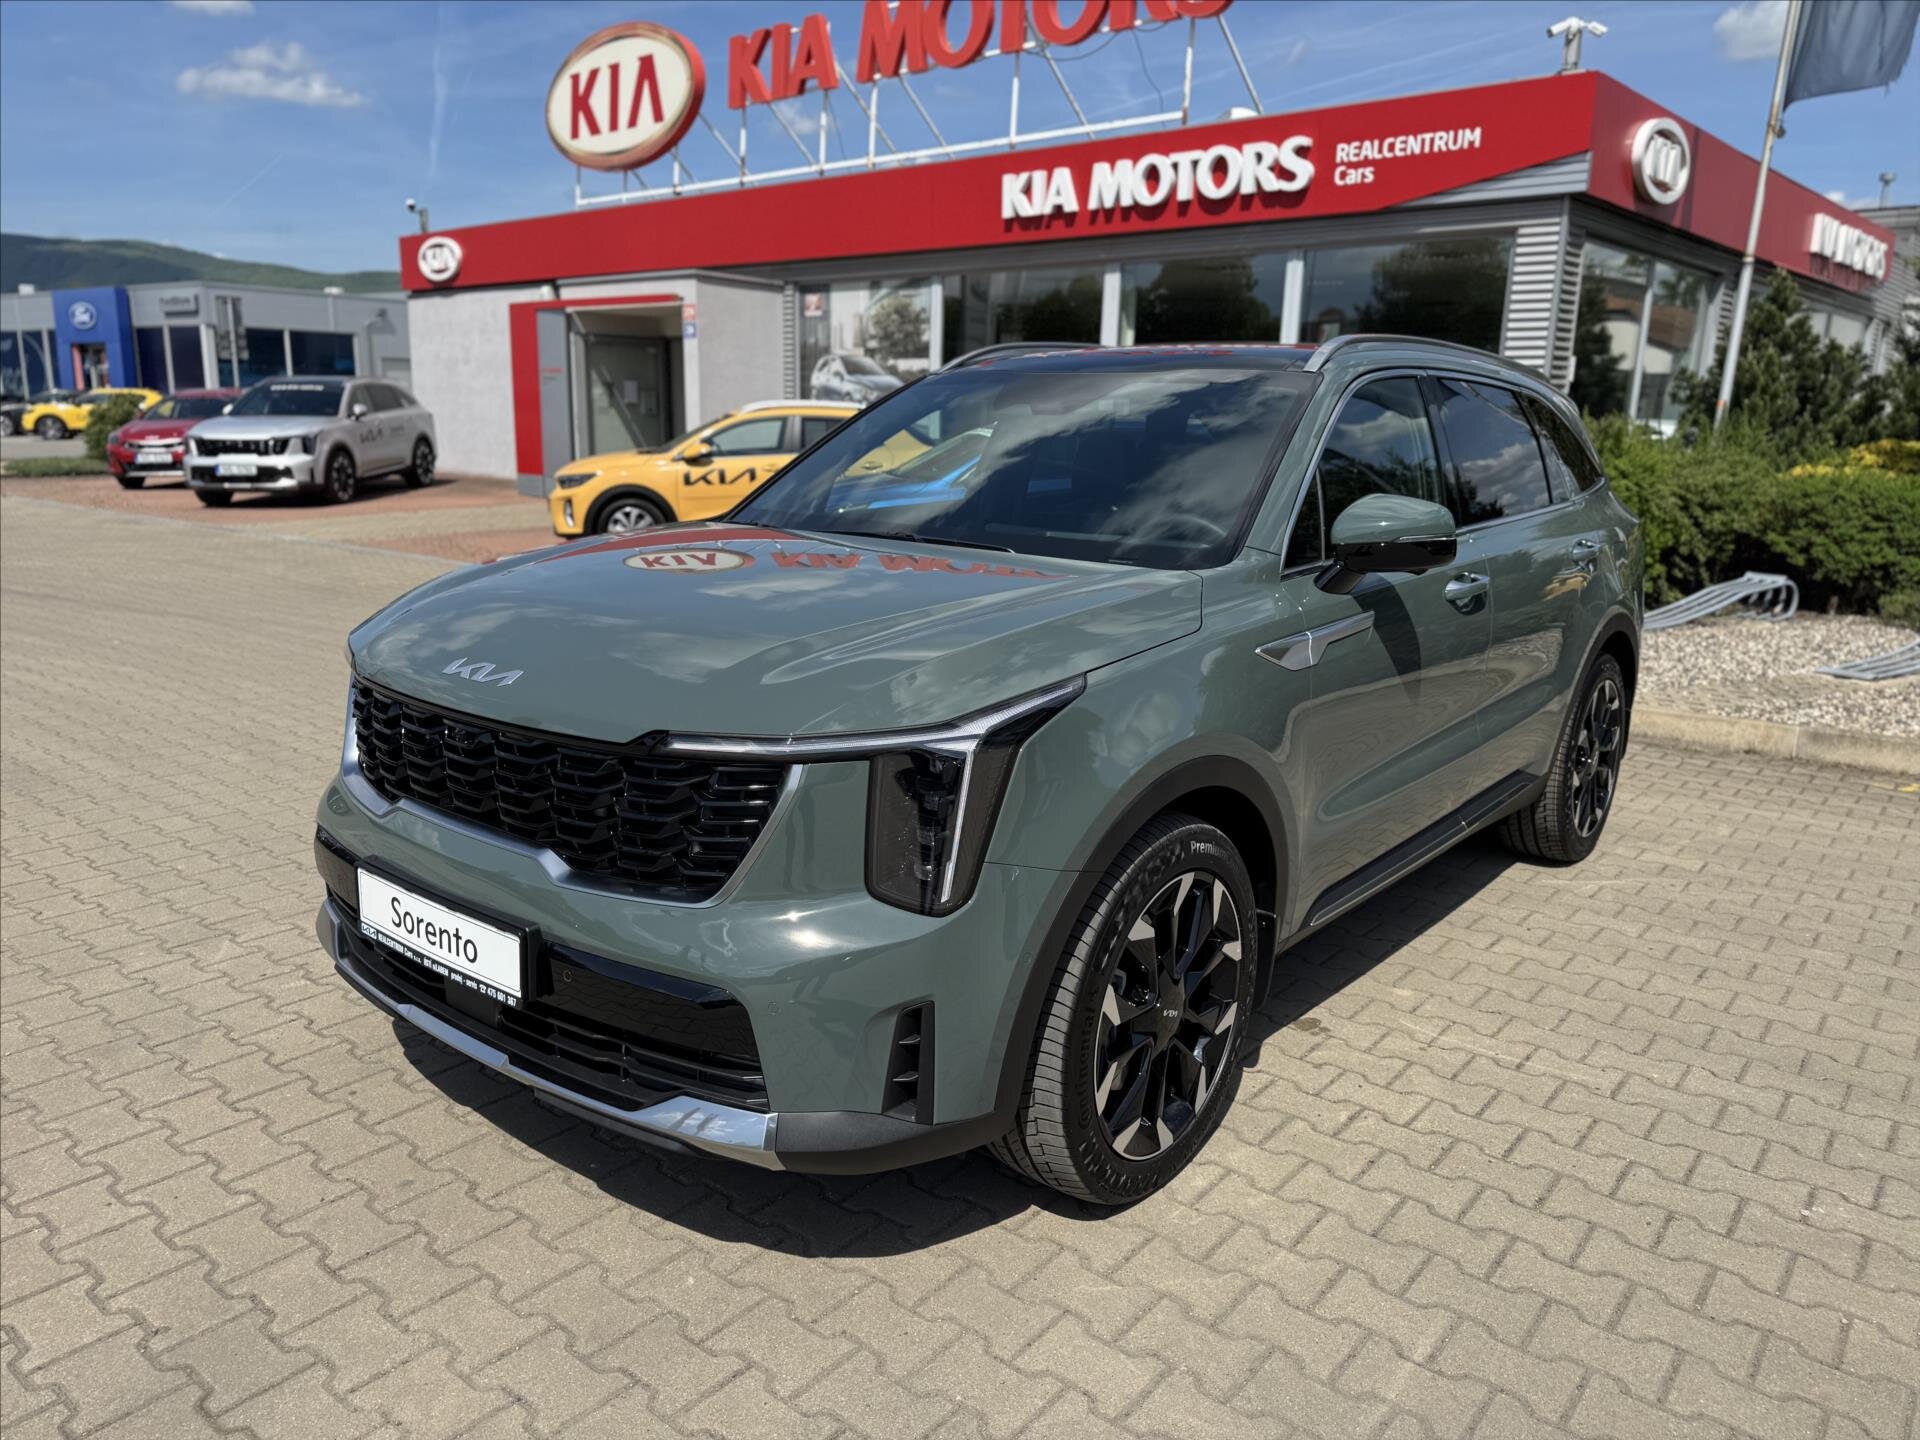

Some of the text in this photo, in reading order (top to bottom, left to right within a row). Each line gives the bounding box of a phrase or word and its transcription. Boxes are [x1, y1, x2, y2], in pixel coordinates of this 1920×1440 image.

[728, 0, 1236, 109] KIA MOTO
[570, 53, 665, 140] KIA
[1335, 127, 1482, 163] REALCENTRUM
[1001, 135, 1315, 219] KIA MOTORS
[1334, 165, 1375, 186] Cars
[684, 467, 756, 486] KIA
[442, 656, 525, 688] KIA
[391, 896, 478, 964] Sorento
